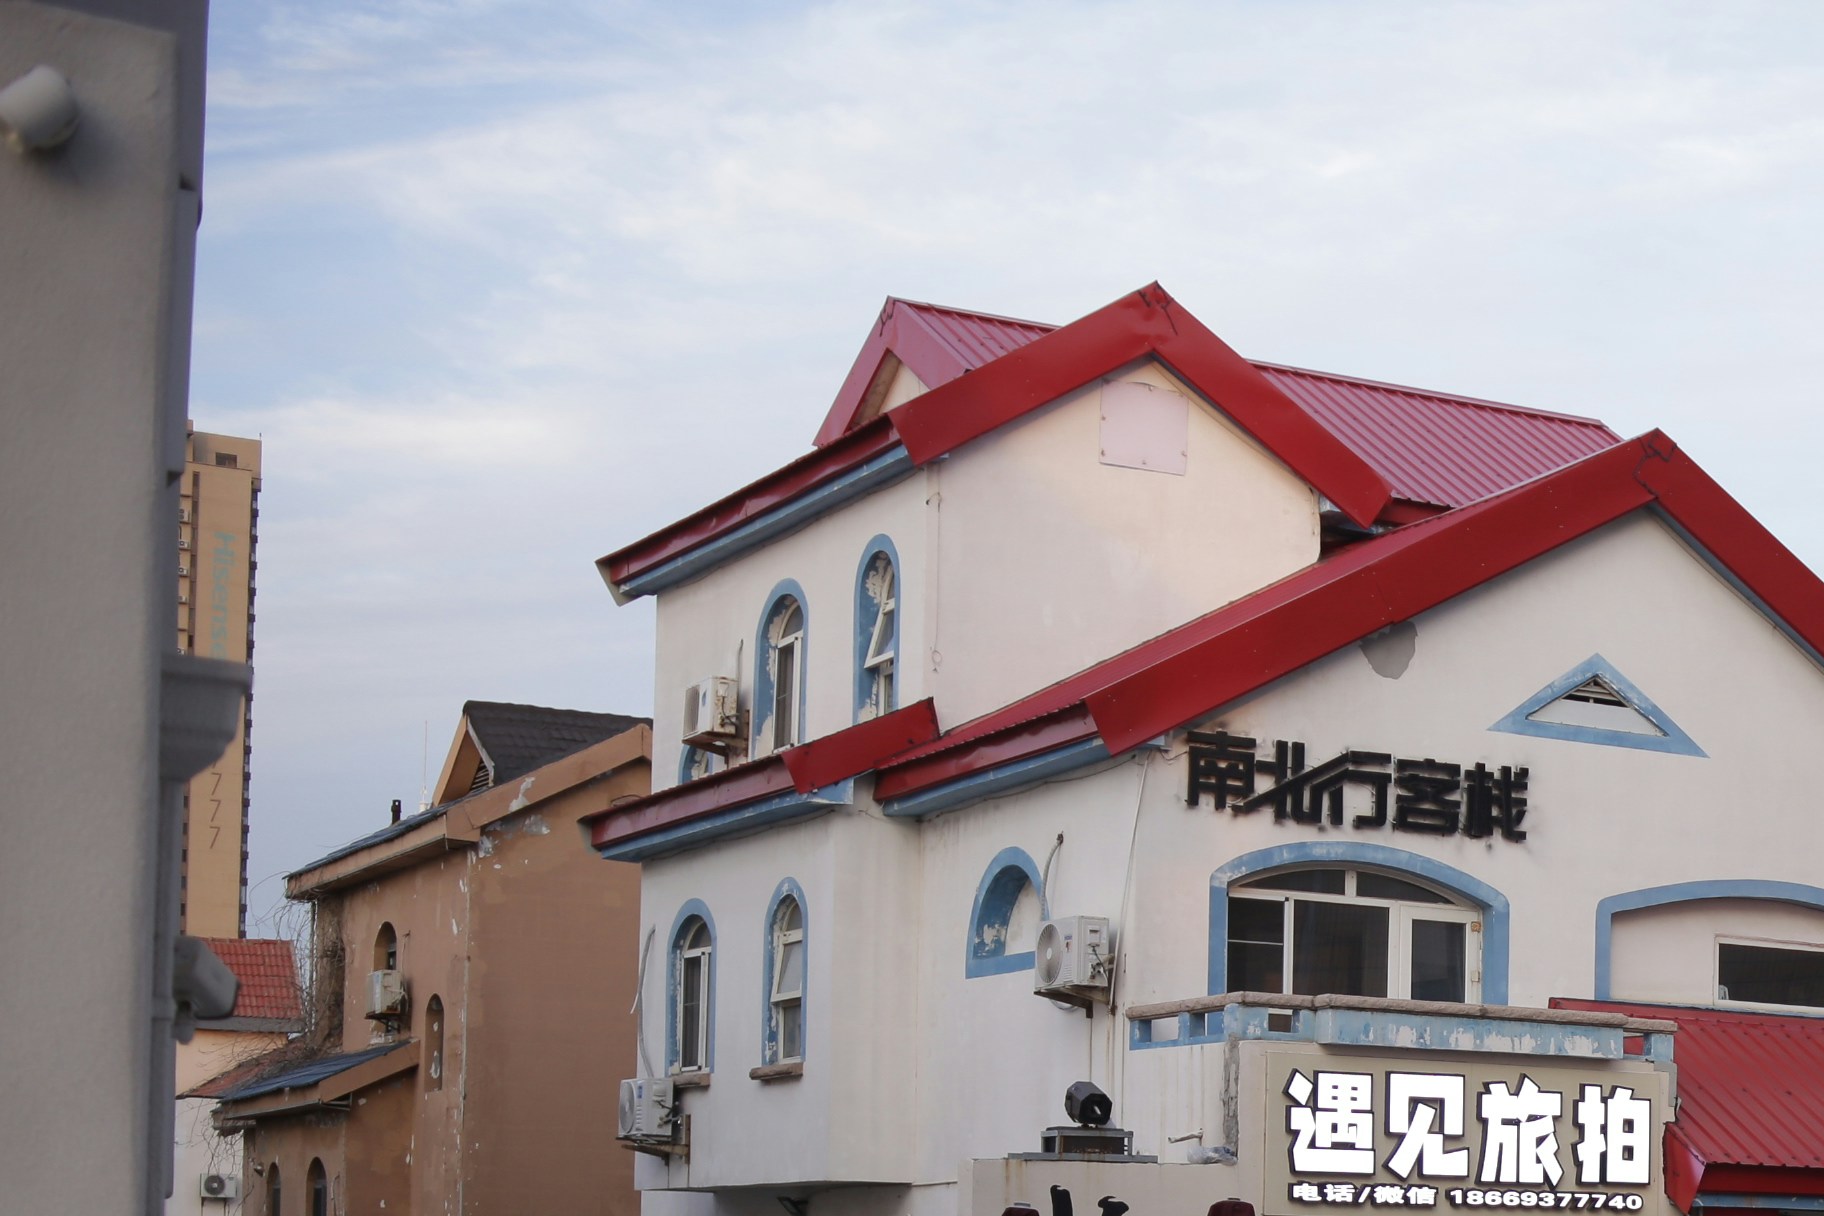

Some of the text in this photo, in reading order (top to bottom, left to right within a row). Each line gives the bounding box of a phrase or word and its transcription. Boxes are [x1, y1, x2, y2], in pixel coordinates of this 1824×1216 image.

[1186, 730, 1530, 842] 南北行客栈
[1283, 1068, 1652, 1188] 遇见旅拍
[1450, 1188, 1644, 1211] 18669377740
